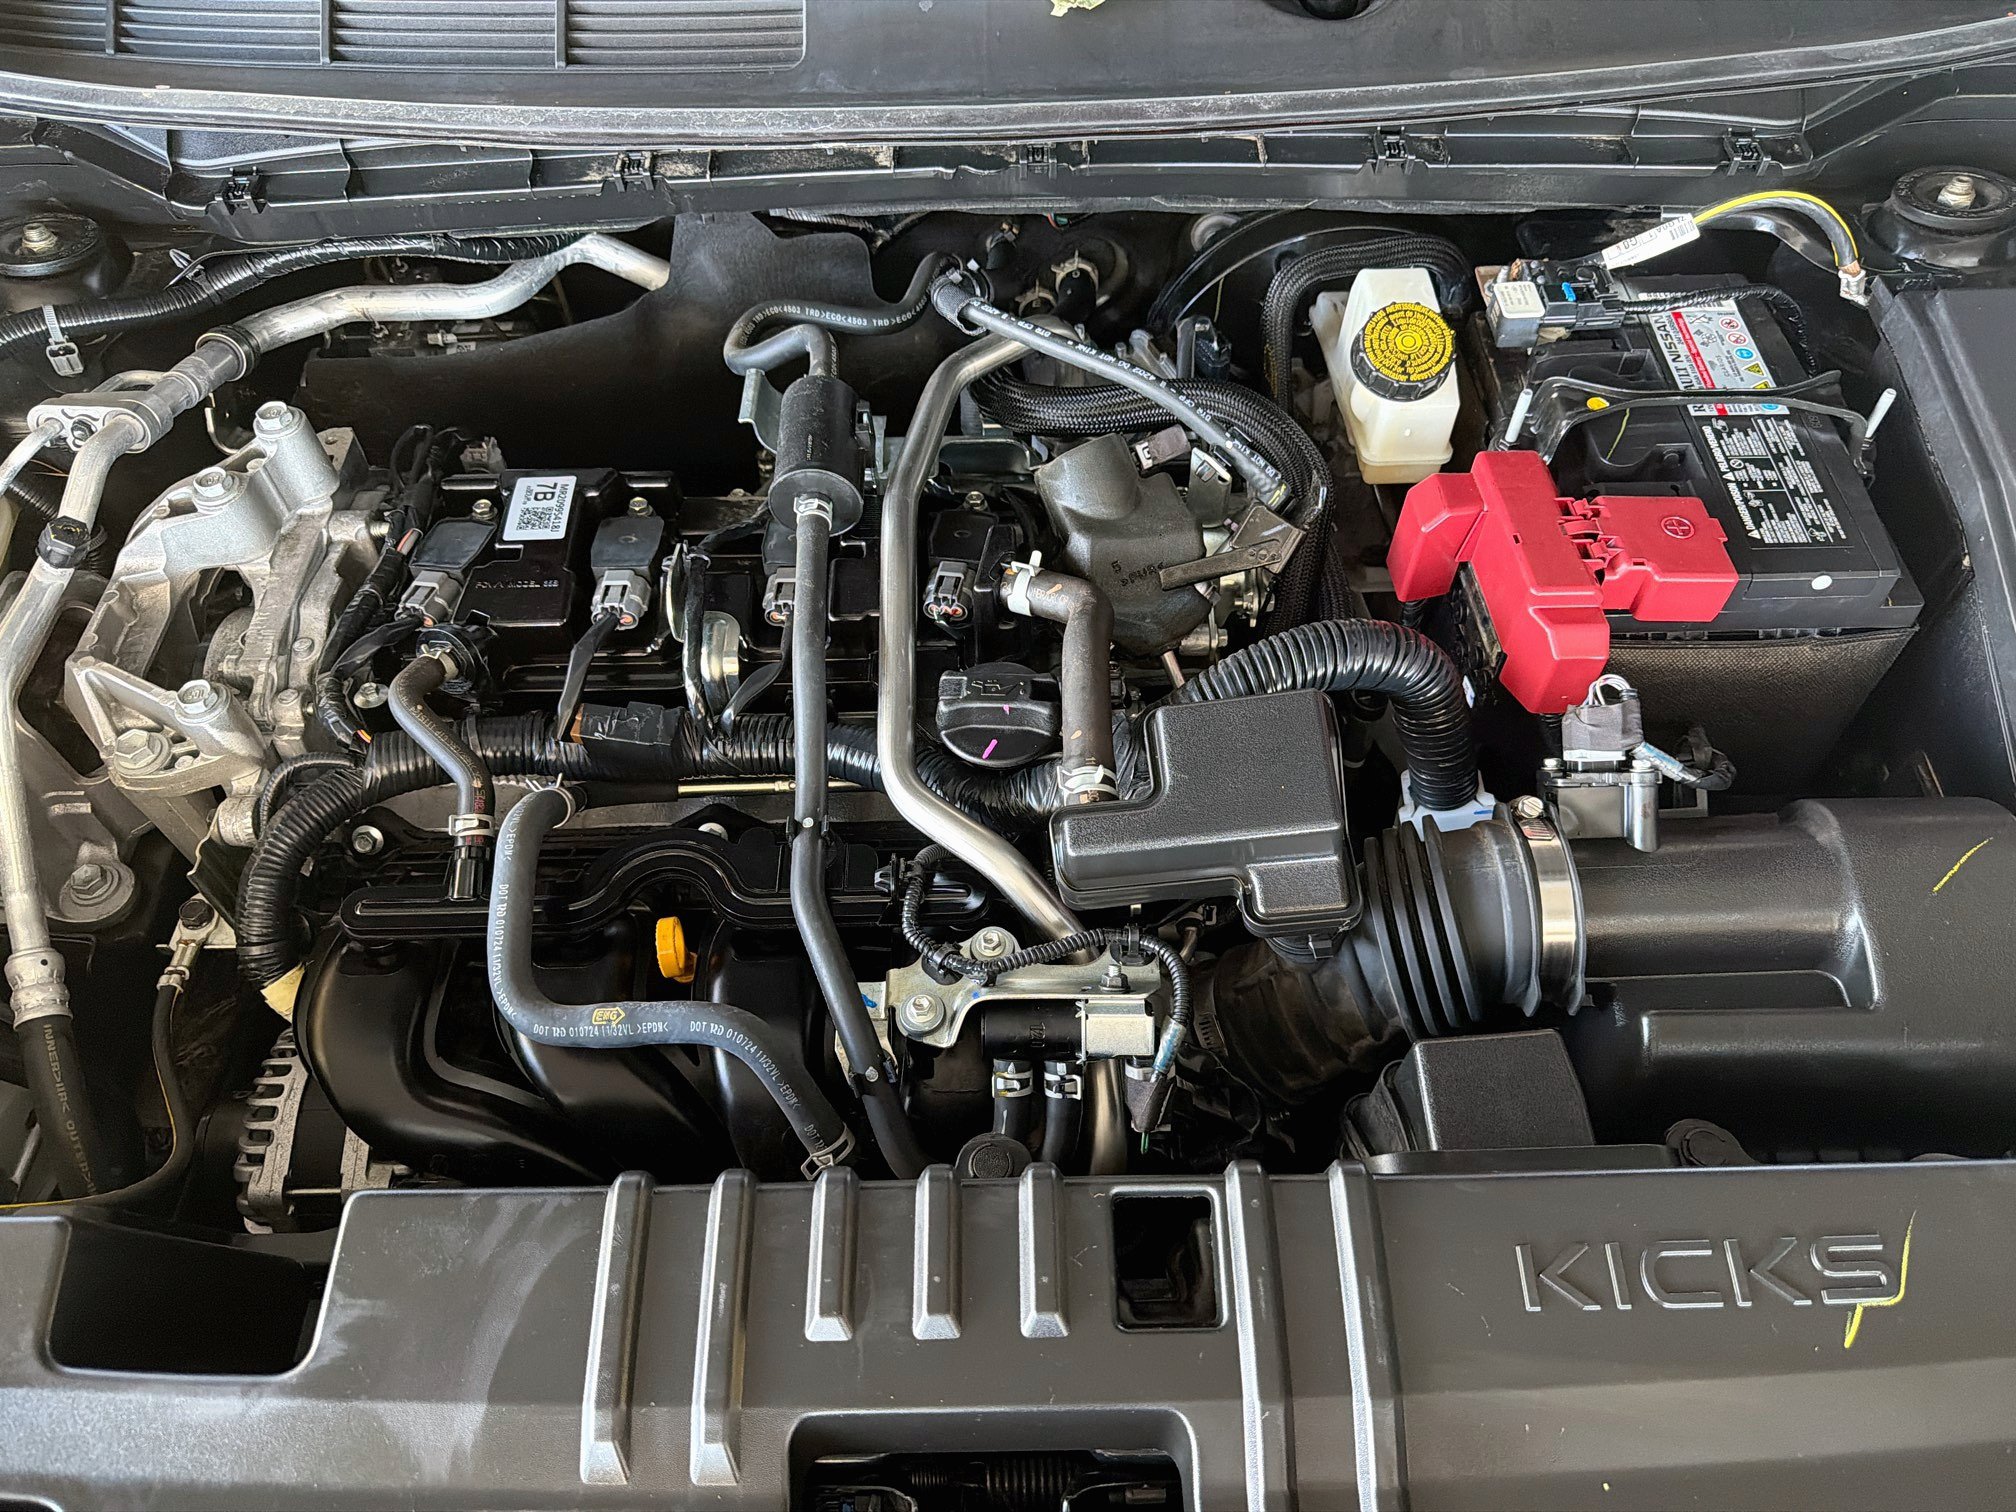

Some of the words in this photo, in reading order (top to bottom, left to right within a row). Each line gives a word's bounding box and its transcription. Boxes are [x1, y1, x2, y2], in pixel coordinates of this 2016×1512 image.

[805, 307, 868, 327] TRD>ECO<4503
[1654, 315, 1682, 363] NISSAN
[1099, 352, 1116, 362] NOT
[1702, 425, 1729, 473] PELIGRO/VENENO
[533, 482, 558, 502] 7B
[1727, 482, 1756, 530] DANGER/POISON
[499, 883, 509, 901] DOT
[533, 1023, 550, 1036] DOT
[569, 1024, 599, 1037] 010724
[636, 1022, 669, 1034] >EPDM<
[690, 1020, 706, 1032] DOT
[726, 1028, 757, 1054] 010724
[755, 1050, 780, 1081] 11/32VL
[777, 1080, 802, 1111] >EPDM<
[1515, 1234, 1901, 1312] KICKS
